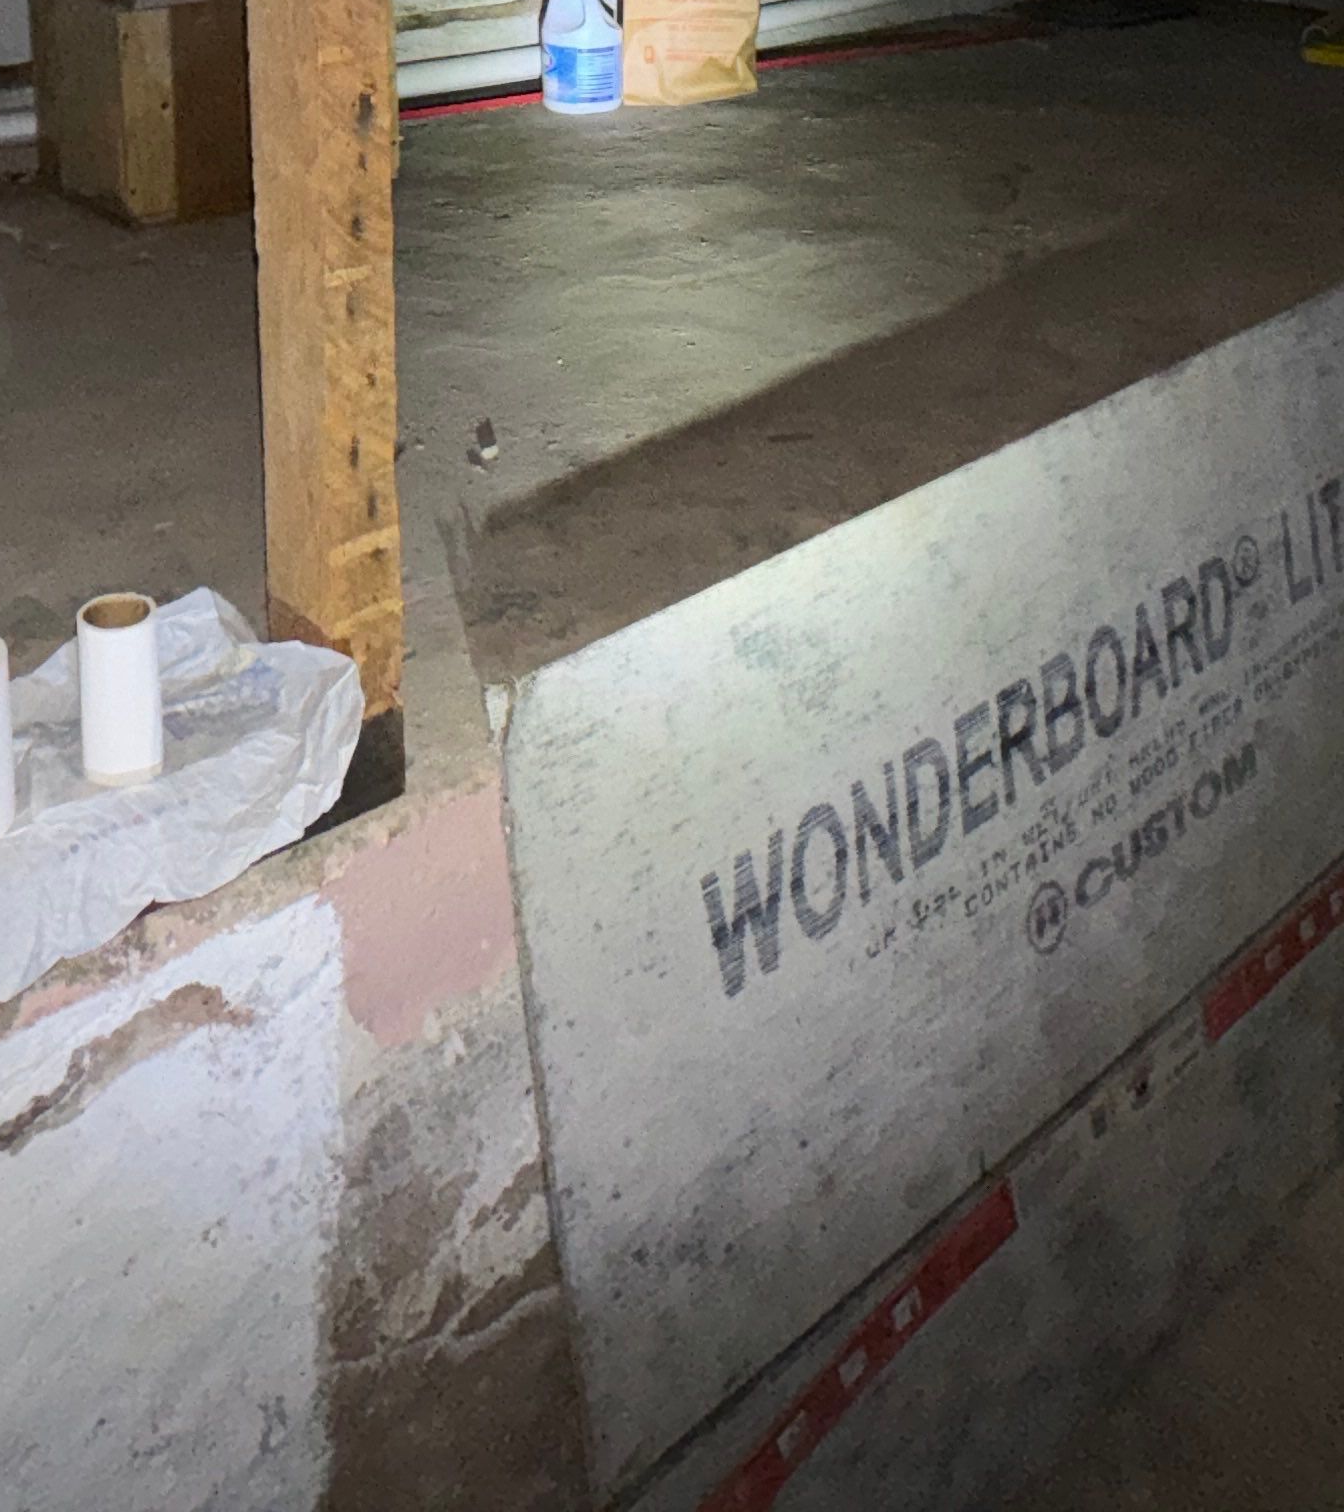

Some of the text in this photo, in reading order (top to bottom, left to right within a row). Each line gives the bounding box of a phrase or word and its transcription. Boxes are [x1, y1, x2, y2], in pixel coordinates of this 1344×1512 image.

[963, 813, 1077, 918] CONTAINS
[1091, 793, 1117, 825] NO
[1129, 746, 1179, 796] WOOD
[1075, 742, 1257, 910] CUSTOM
